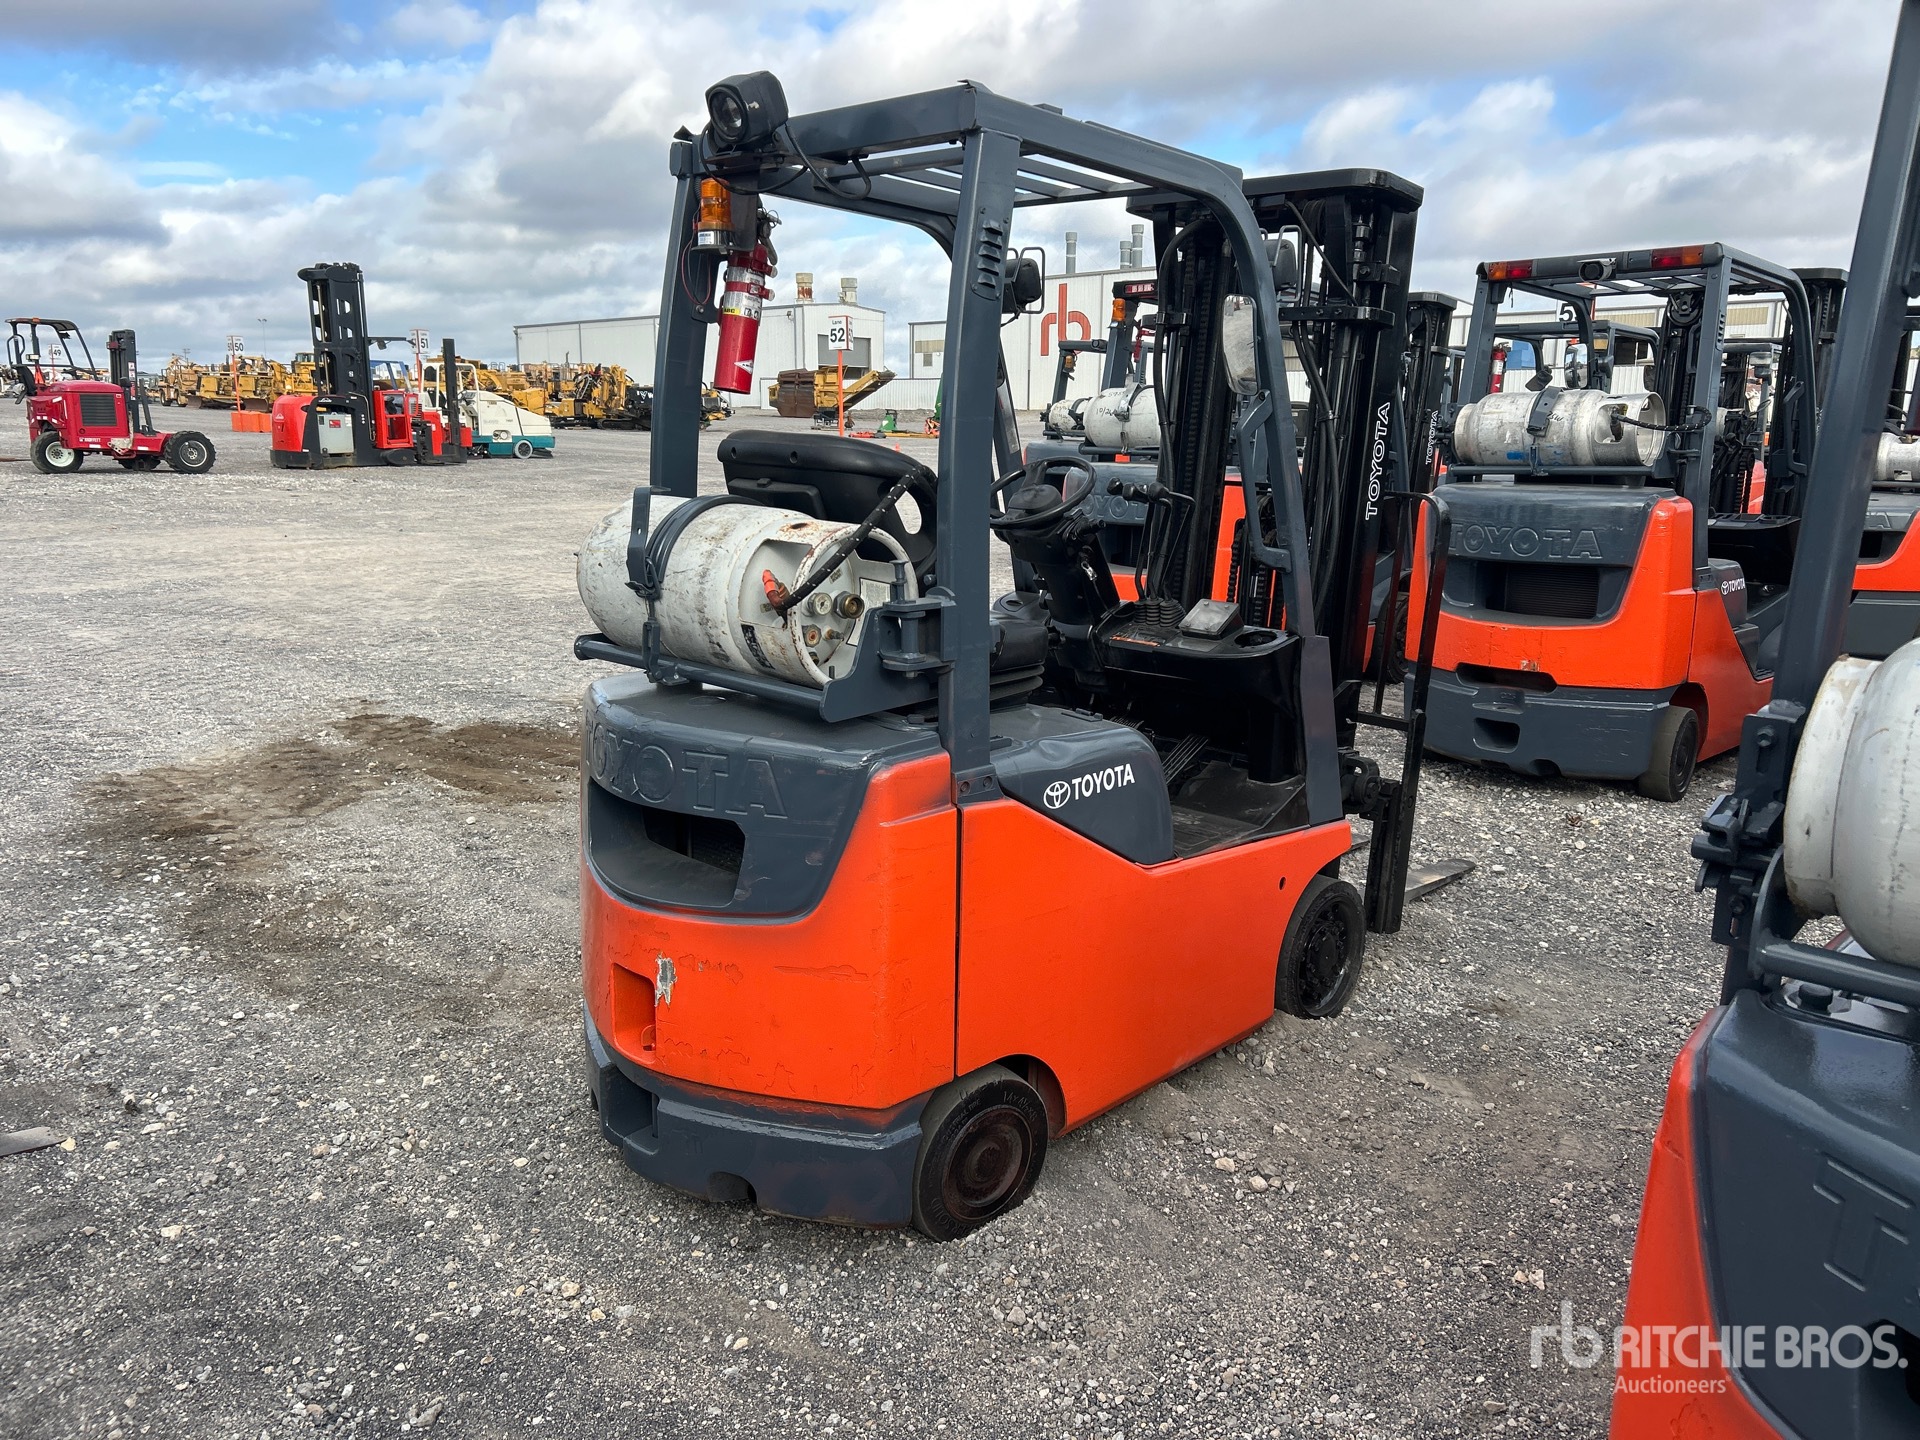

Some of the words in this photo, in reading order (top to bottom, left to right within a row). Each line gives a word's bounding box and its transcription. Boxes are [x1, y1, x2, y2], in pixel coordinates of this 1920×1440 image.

[1040, 282, 1092, 357] rb
[1558, 302, 1577, 322] 5
[234, 342, 244, 352] 50
[420, 337, 429, 349] 51
[829, 327, 846, 343] 52
[53, 348, 62, 357] 49
[1425, 410, 1439, 465] TOYOTA
[1365, 401, 1391, 521] TOYOTA
[1448, 523, 1603, 559] TOYOTA
[1728, 577, 1746, 593] TOYOTA
[586, 718, 788, 820] TOYOTA
[1071, 763, 1136, 801] TOYOTA
